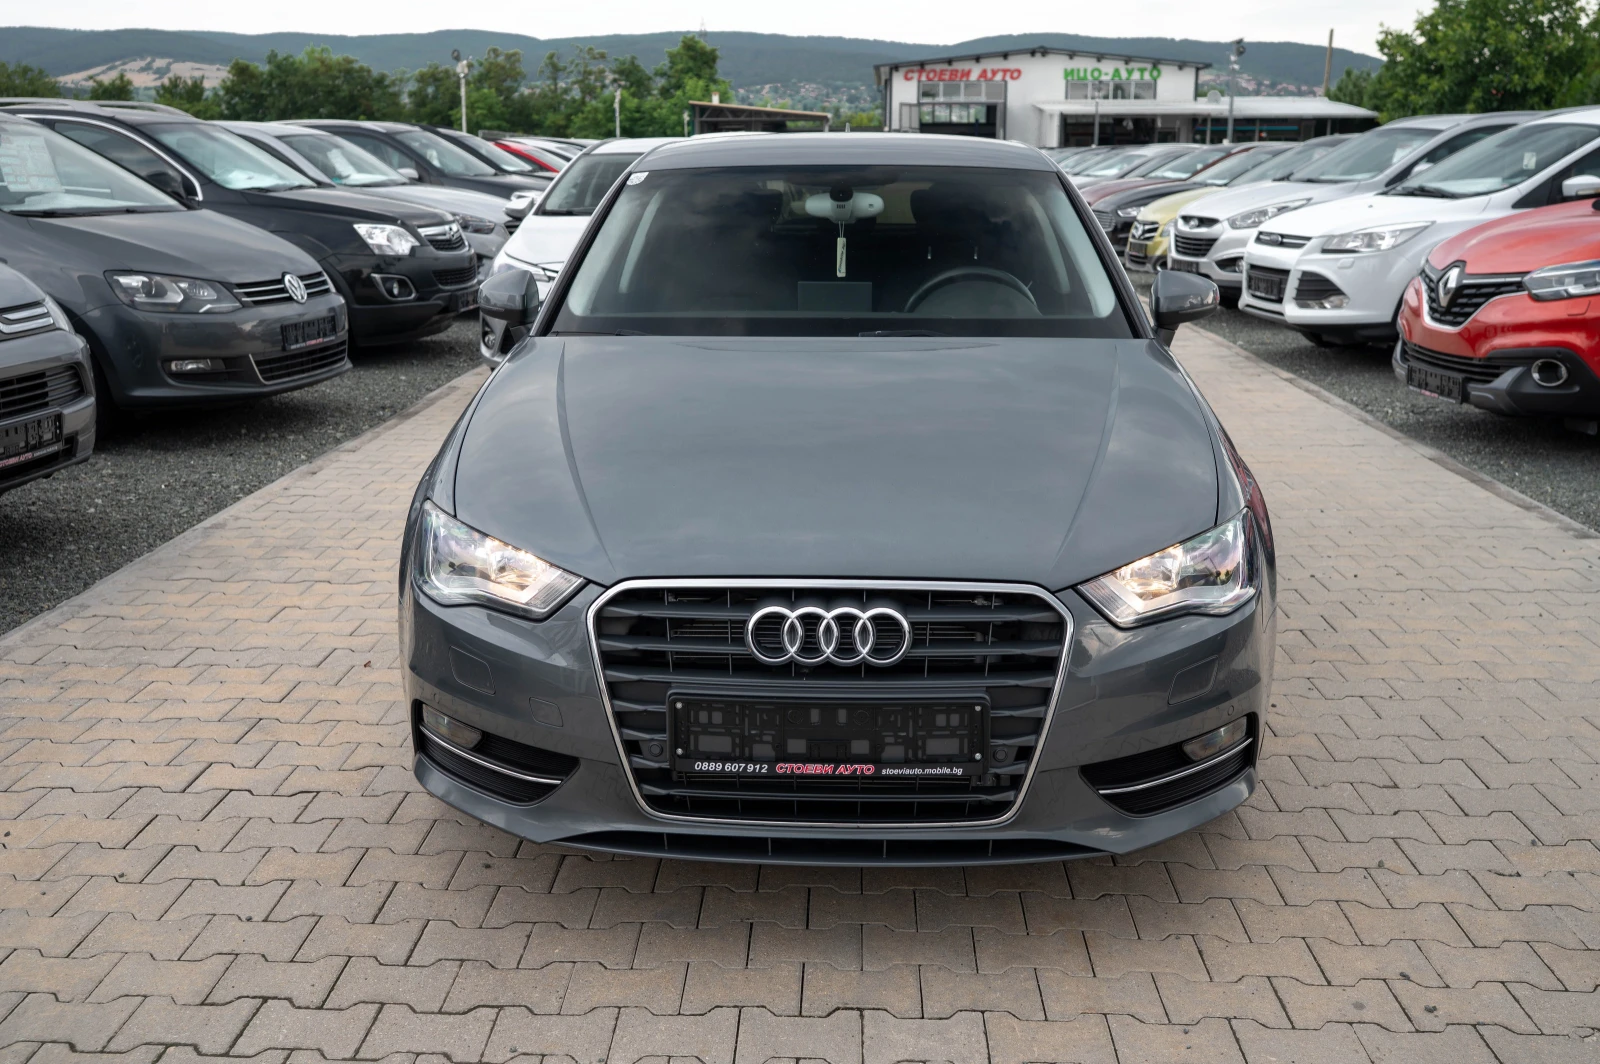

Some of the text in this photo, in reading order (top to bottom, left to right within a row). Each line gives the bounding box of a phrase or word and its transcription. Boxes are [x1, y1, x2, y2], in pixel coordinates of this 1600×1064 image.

[904, 68, 1022, 81] СТОЕВИ АУТО
[1063, 67, 1162, 81] ИЦО-АУТО
[694, 762, 963, 776] 0889 607 912 СТОЕВИ АУТО stoeviauto.mobile.bg
